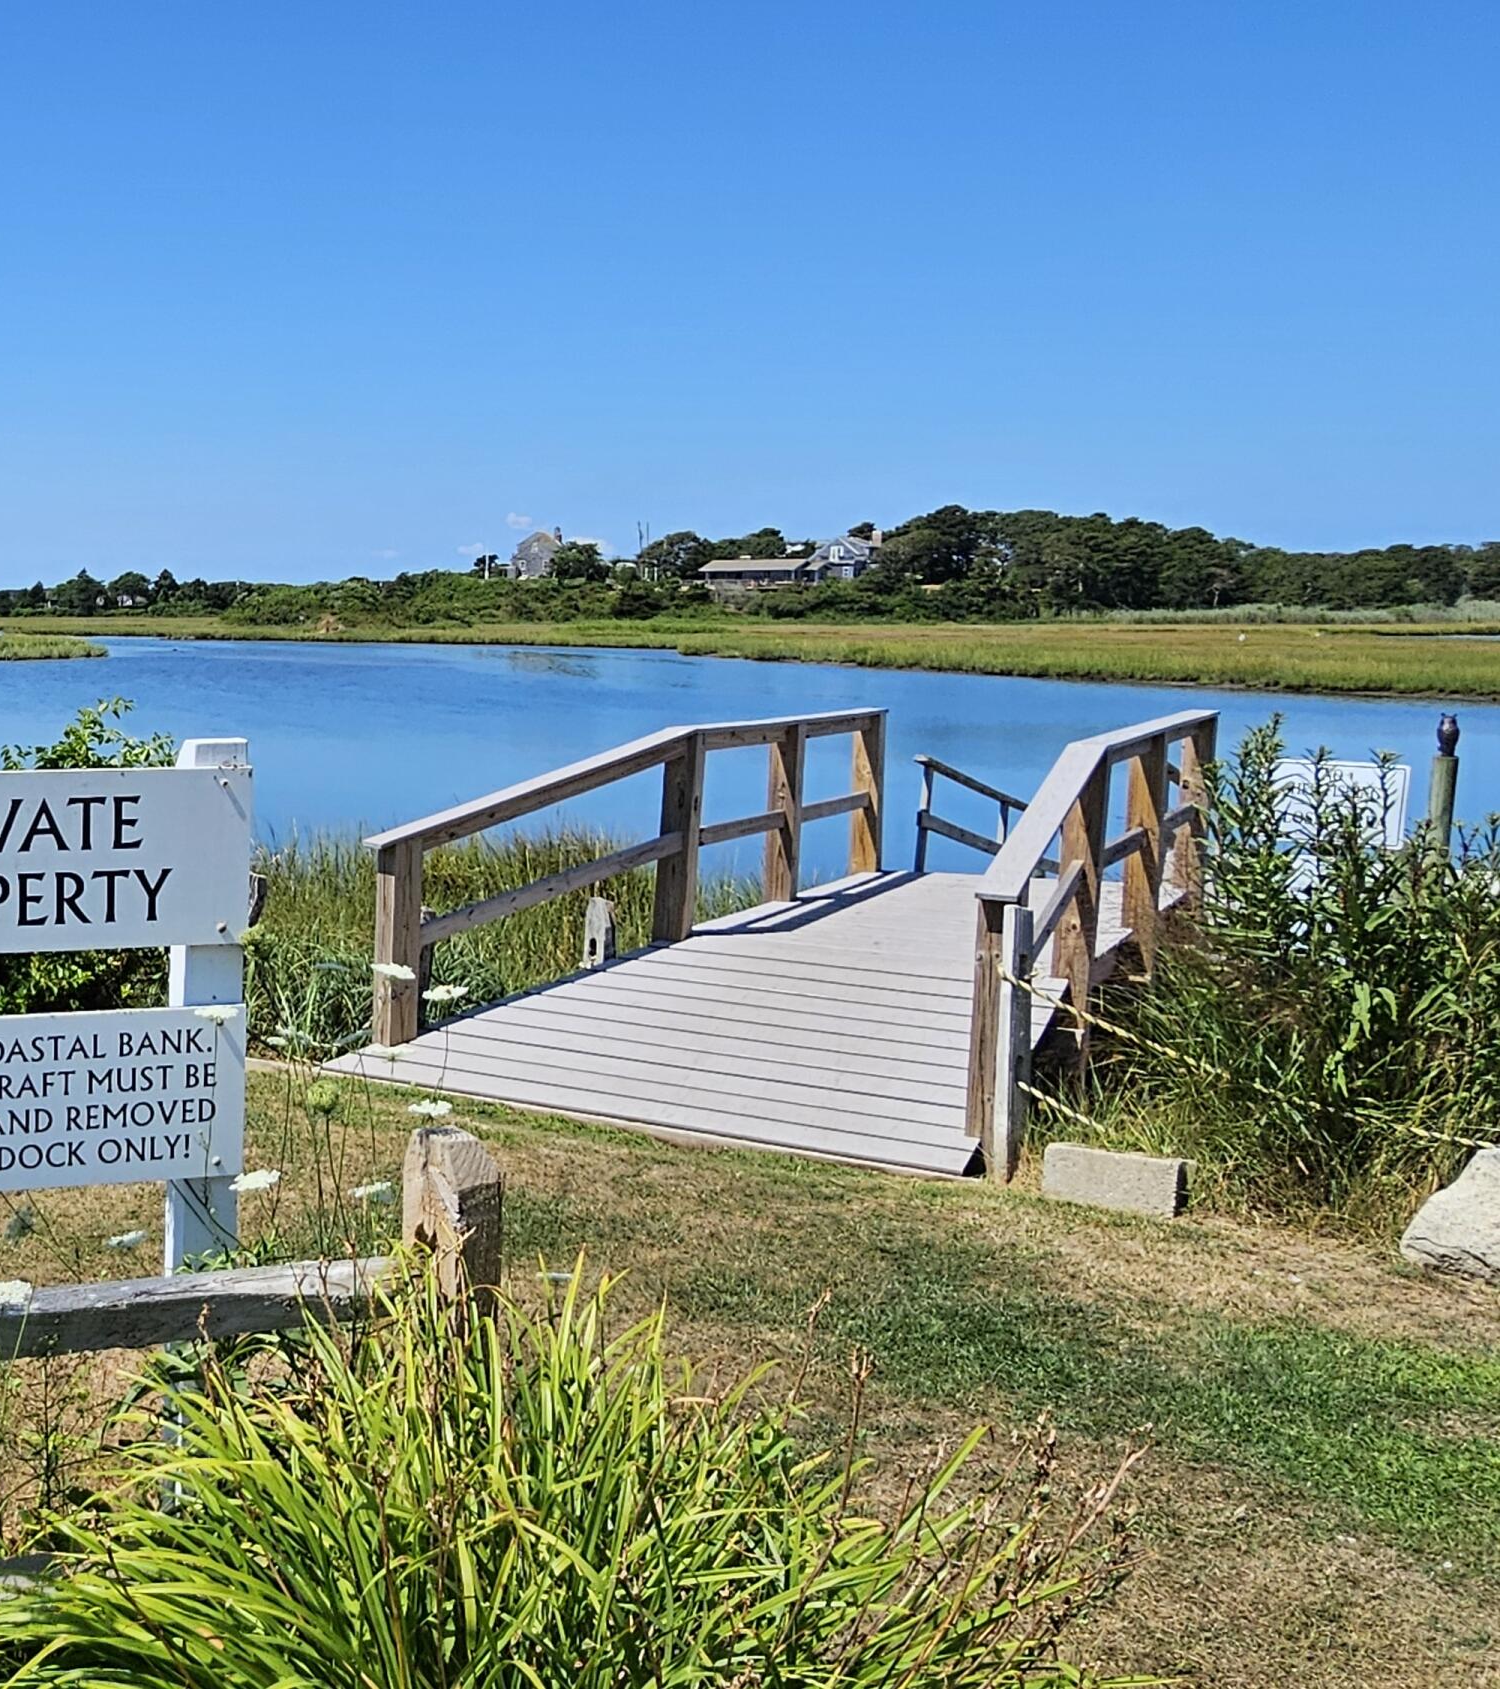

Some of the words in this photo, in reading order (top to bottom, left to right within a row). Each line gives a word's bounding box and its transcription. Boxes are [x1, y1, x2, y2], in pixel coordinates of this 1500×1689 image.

[119, 1028, 212, 1058] BANK.
[87, 1064, 174, 1095] MUST
[185, 1062, 217, 1089] BE
[66, 1098, 216, 1134] REMOVED
[97, 1133, 190, 1164] ONLY!
